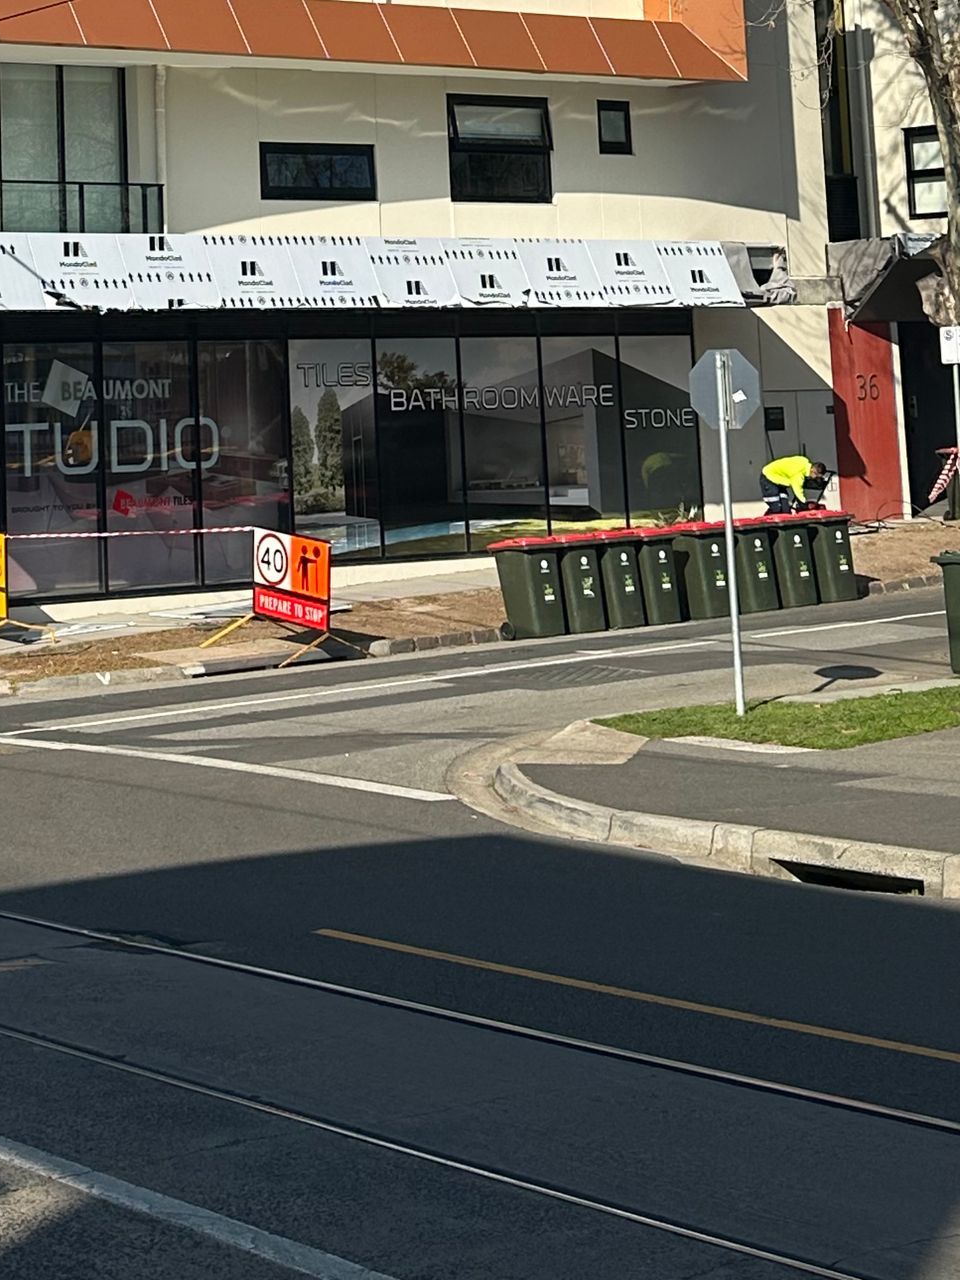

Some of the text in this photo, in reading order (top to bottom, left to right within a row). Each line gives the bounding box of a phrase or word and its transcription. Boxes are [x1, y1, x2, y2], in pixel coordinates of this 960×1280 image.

[297, 362, 371, 388] TILES
[856, 374, 881, 401] 36
[4, 379, 172, 402] THE BEAUMONT
[624, 407, 695, 428] STONE
[261, 547, 284, 573] 40
[259, 594, 324, 623] PREPARE TO STOP
